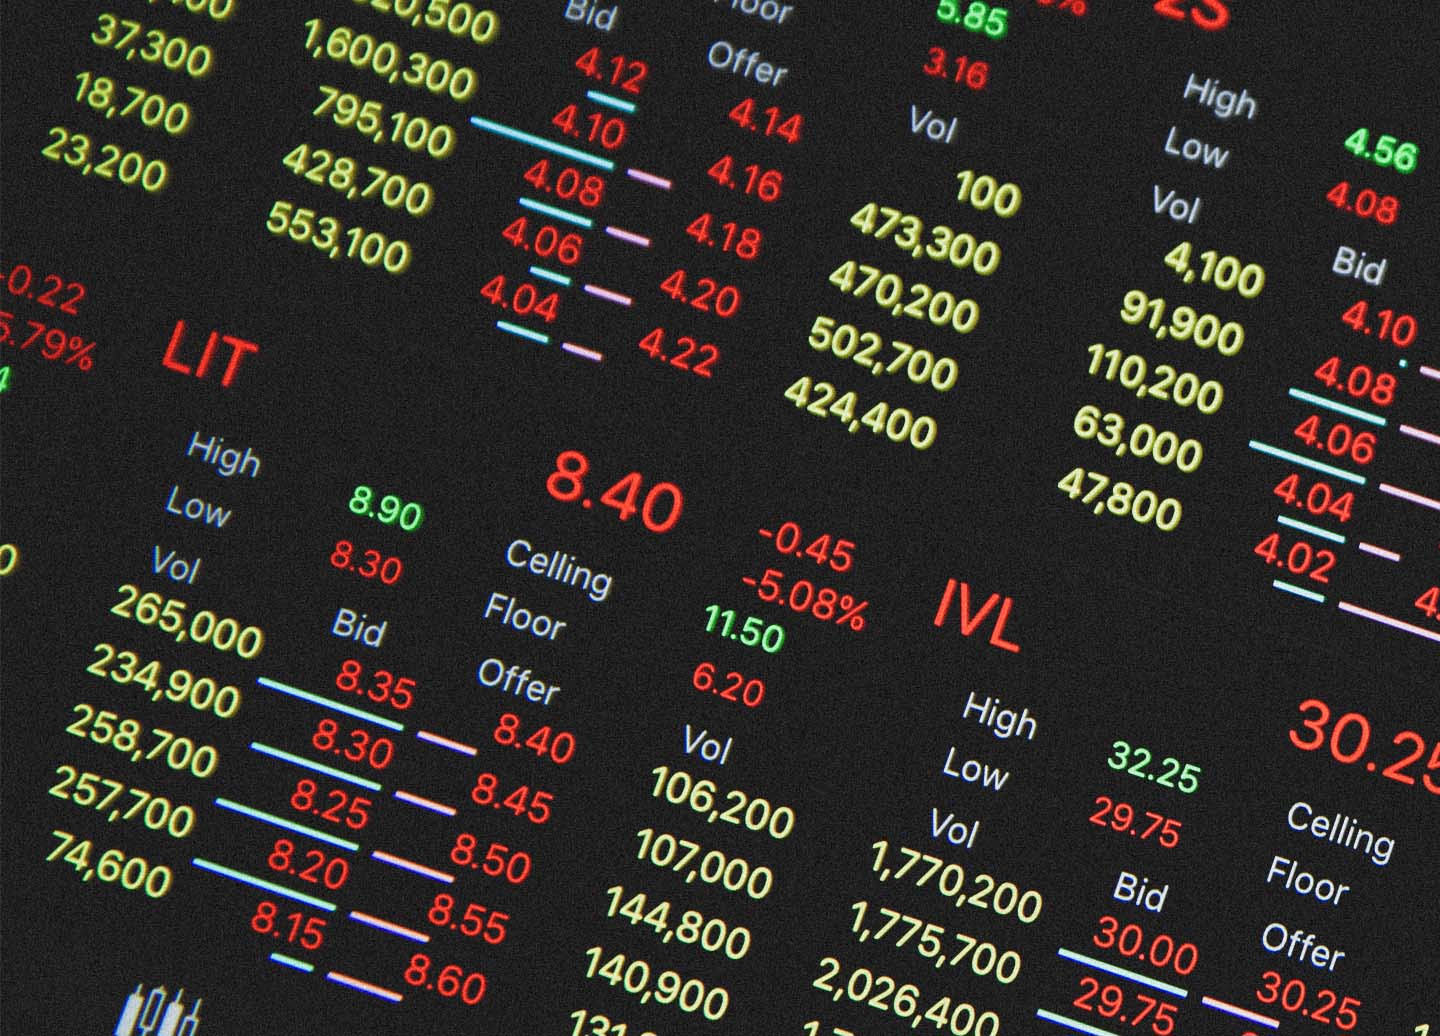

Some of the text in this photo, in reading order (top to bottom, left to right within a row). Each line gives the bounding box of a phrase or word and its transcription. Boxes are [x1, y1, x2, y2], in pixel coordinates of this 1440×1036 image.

[713, 0, 794, 24] oor
[937, 0, 1008, 38] 5.85
[93, 14, 212, 77] 37,300
[306, 19, 476, 100] 1,600,300
[576, 48, 648, 94] 4.12
[707, 41, 788, 87] Offer
[924, 47, 989, 90] 3.16
[77, 72, 190, 134] 18,700
[729, 98, 803, 144] 4.14
[1184, 73, 1256, 119] High
[314, 86, 454, 158] 795,100
[552, 104, 627, 149] 4.10
[911, 105, 957, 143] Vol
[1165, 126, 1229, 168] Low
[44, 127, 168, 191] 23,200
[1344, 128, 1418, 173] 4.56
[285, 144, 433, 215] 428,700
[524, 159, 605, 207] 4.08
[707, 155, 783, 202] 4.16
[957, 170, 1021, 217] 100
[1327, 181, 1400, 225] 4.08
[1154, 185, 1200, 224] Vol
[268, 201, 410, 273] 553,100
[502, 217, 583, 265] 4.06
[686, 213, 762, 260] 4.18
[851, 203, 1000, 275] 473,300
[1165, 242, 1265, 298] 4,100
[1332, 246, 1388, 286] Bid
[480, 275, 560, 322] 4.04
[660, 269, 741, 318] 4.20
[831, 261, 979, 333] 470,200
[1120, 290, 1244, 356] 91,900
[1342, 300, 1417, 348] 4.10
[162, 320, 259, 387] LIT
[639, 328, 720, 378] 4.22
[810, 316, 958, 391] 502,700
[1088, 344, 1223, 414] 110,200
[1314, 356, 1397, 406] 4.08
[785, 377, 937, 449] 424,400
[1075, 405, 1202, 472] 63,000
[187, 432, 260, 477] High
[1295, 415, 1377, 464] 4.06
[166, 486, 232, 528] Low
[349, 486, 423, 531] 8.90
[546, 450, 684, 533] 8.40
[1059, 468, 1182, 531] 47,800
[1274, 474, 1354, 522] 4.04
[154, 546, 201, 584] Vol
[330, 540, 403, 585] 8.30
[506, 540, 612, 602] Celling
[759, 521, 856, 572] -0.45
[1254, 532, 1336, 583] 4.02
[111, 584, 264, 658] 265,000
[484, 593, 566, 641] Floor
[742, 568, 868, 631] -5.08%
[934, 578, 1020, 653] IVL
[332, 608, 388, 648] Bid
[705, 605, 785, 653] 11.50
[87, 643, 241, 718] 234,900
[336, 659, 416, 710] 8.35
[478, 659, 560, 706] Offer
[693, 662, 765, 707] 6.20
[66, 704, 219, 777] 258,700
[494, 713, 576, 764] 8.40
[963, 692, 1037, 741] High
[312, 719, 394, 769] 8.30
[685, 724, 733, 766] Vol
[943, 747, 1009, 791] Low
[1107, 741, 1201, 793] 32.25
[49, 765, 195, 838] 257,700
[290, 779, 372, 830] 8.25
[471, 773, 554, 824] 8.45
[652, 766, 795, 839] 106,200
[1089, 796, 1182, 848] 29.75
[933, 808, 979, 849] Vol
[1288, 802, 1395, 866] Celling
[46, 830, 173, 898] 74,600
[268, 839, 349, 890] 8.20
[450, 833, 531, 884] 8.50
[637, 828, 773, 899] 107,000
[872, 841, 1042, 923] 1,770,200
[1267, 856, 1350, 906] Floor
[1113, 872, 1169, 913] Bid
[251, 901, 327, 950] 8.15
[428, 893, 510, 944] 8.55
[606, 886, 751, 959] 144,800
[852, 901, 1021, 983] 1,775,700
[1093, 916, 1198, 975] 30.00
[1262, 923, 1346, 972] Offer
[404, 953, 487, 1005] 8.60
[585, 946, 729, 1021] 140,900
[813, 956, 1000, 1036] 2,026,400
[1256, 971, 1360, 1030] 30.25
[1073, 976, 1178, 1036] 29.75
